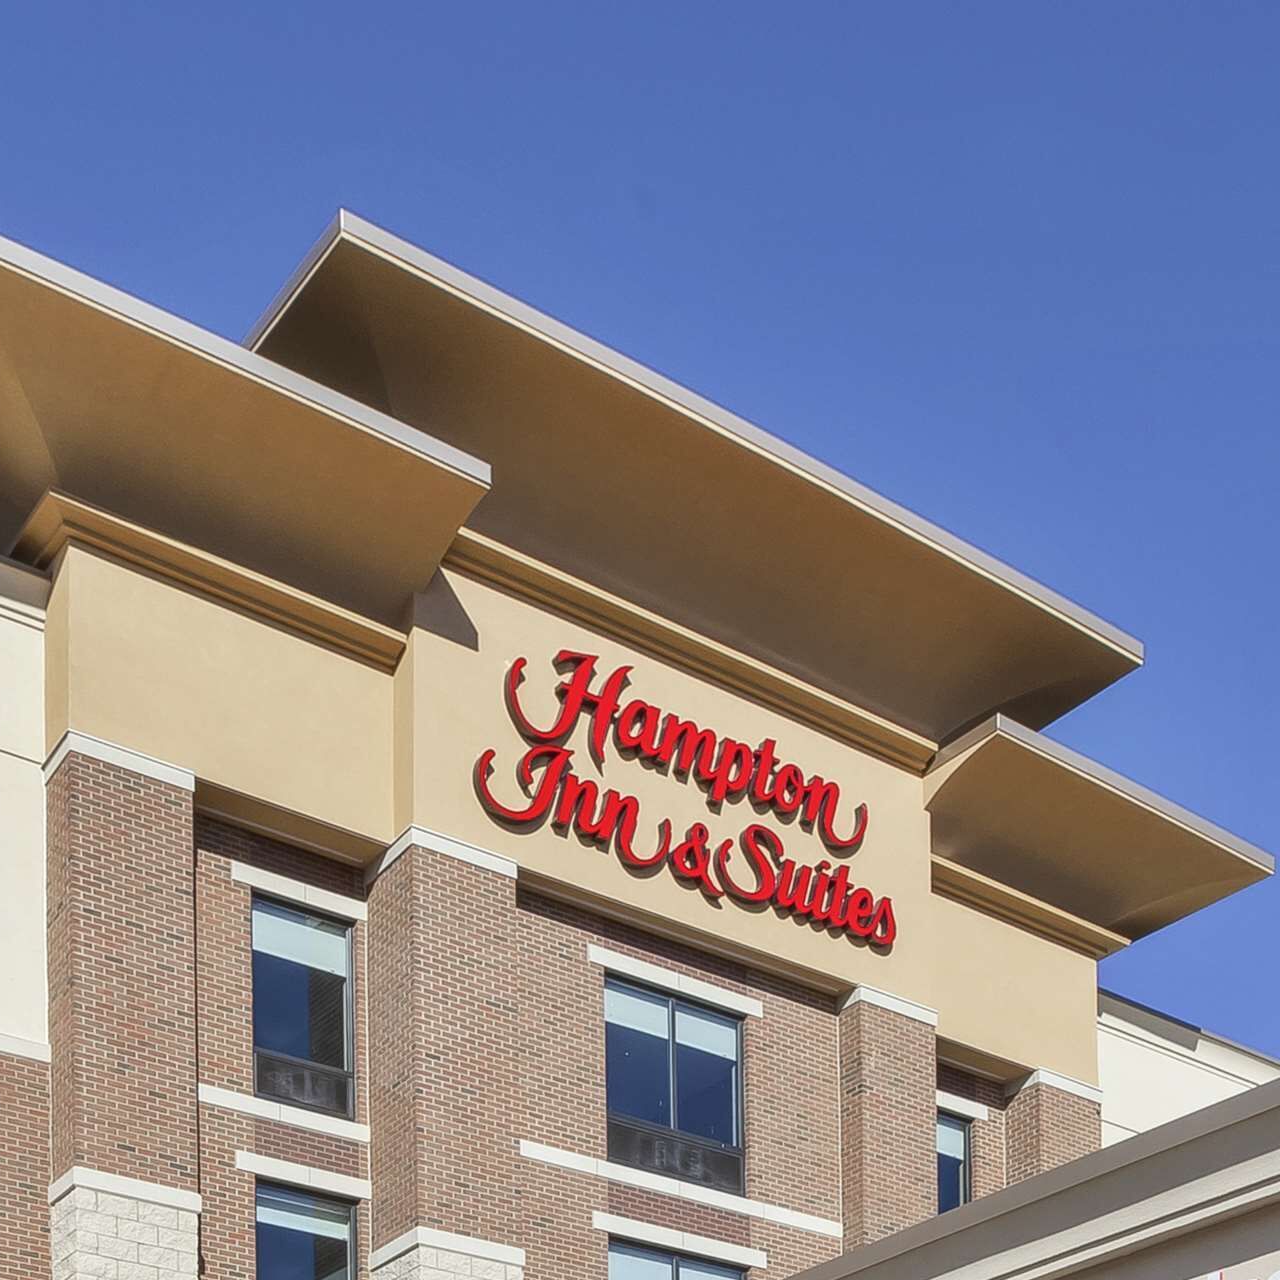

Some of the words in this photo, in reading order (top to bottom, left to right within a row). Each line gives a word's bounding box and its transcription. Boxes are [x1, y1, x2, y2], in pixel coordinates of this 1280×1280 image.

[473, 745, 672, 878] Inn
[669, 822, 723, 909] &
[714, 824, 897, 957] Suites
[504, 649, 869, 857] Hampton
